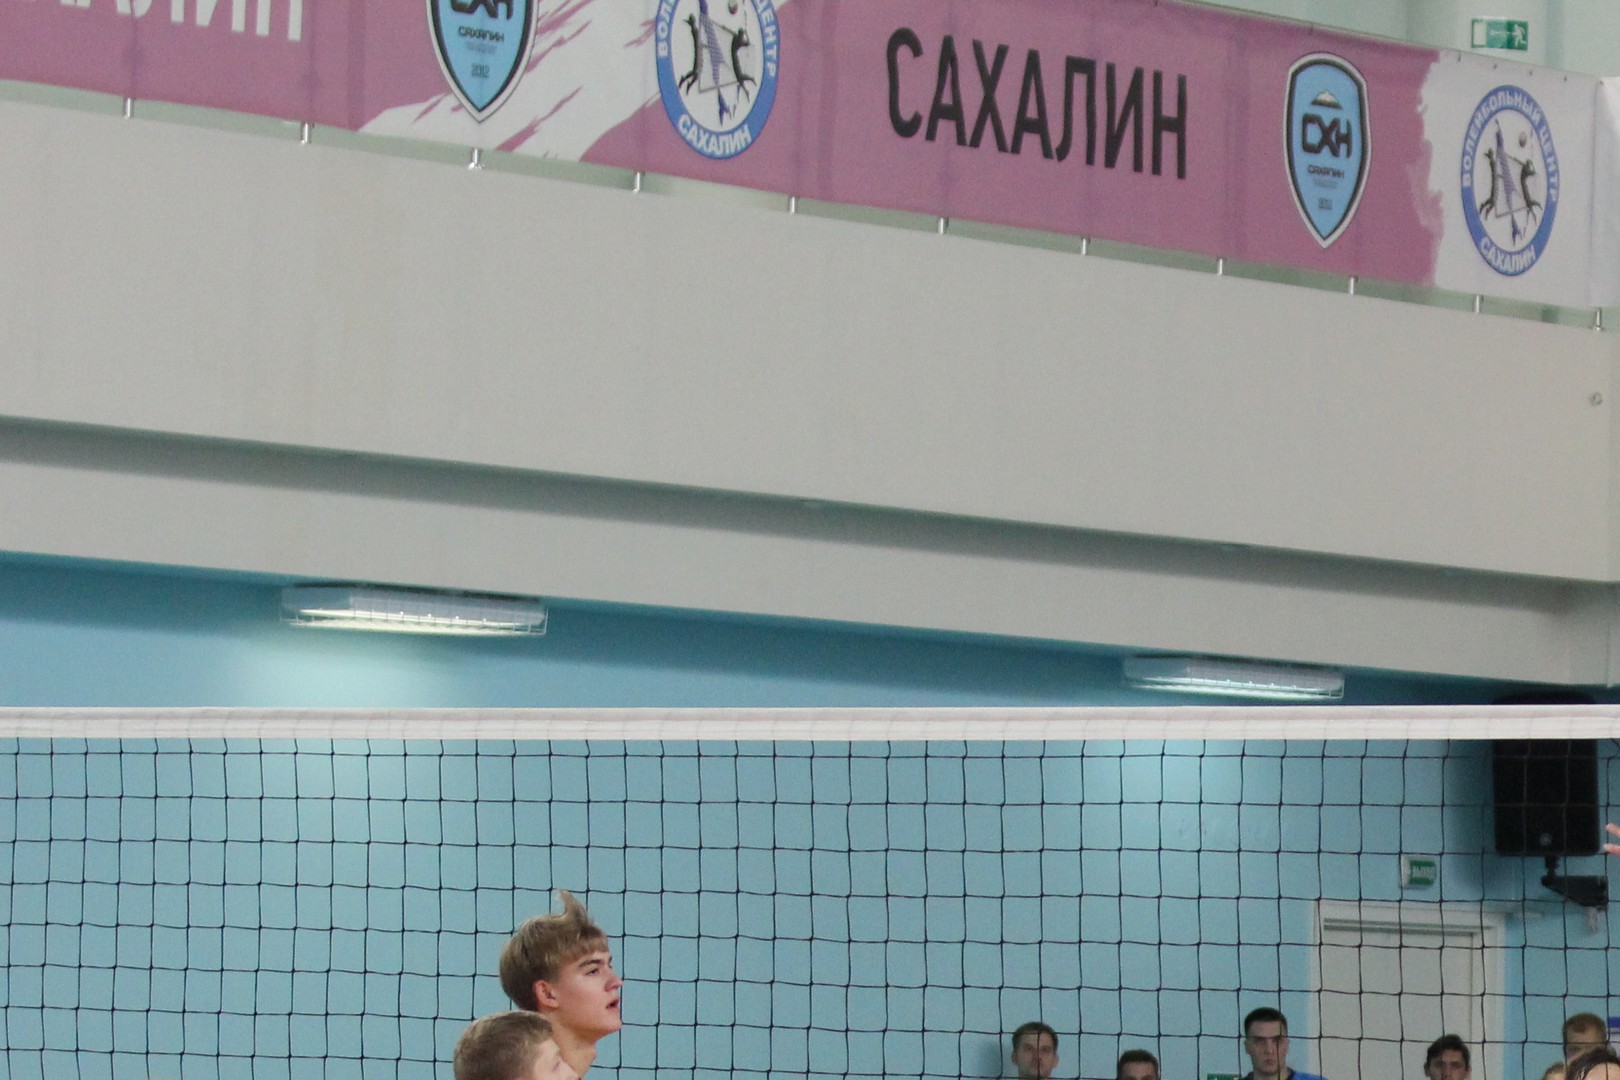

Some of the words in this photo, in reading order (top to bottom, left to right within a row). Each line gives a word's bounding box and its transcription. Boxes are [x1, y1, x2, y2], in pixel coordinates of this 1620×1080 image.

[886, 27, 1187, 179] САХАЛИН
[678, 114, 752, 155] САХАЛИН
[1480, 236, 1537, 273] САХАЛИН
